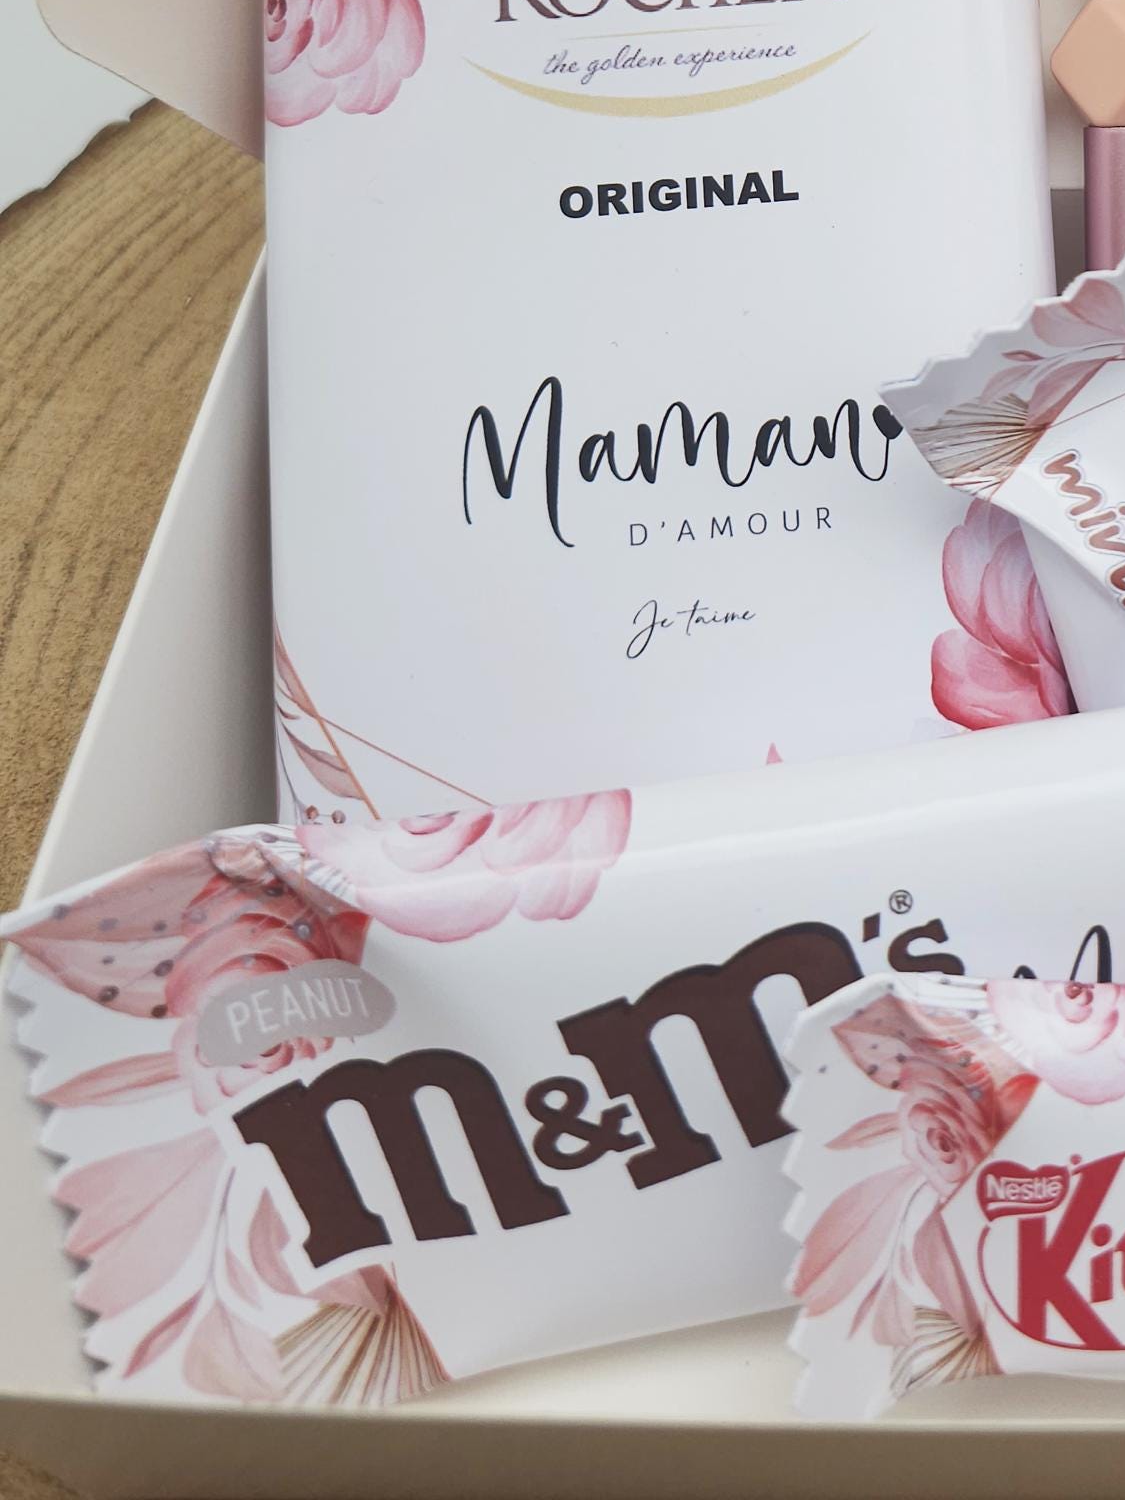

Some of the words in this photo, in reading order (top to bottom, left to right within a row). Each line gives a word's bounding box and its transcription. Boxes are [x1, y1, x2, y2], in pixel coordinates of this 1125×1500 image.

[543, 49, 580, 75] the
[581, 44, 667, 85] golden
[673, 43, 797, 78] experience
[558, 170, 800, 218] ORIGINAL
[462, 376, 890, 548] Maman
[629, 506, 833, 547] D'AMOUR
[626, 599, 674, 659] Je
[226, 976, 373, 1044] PEANUT
